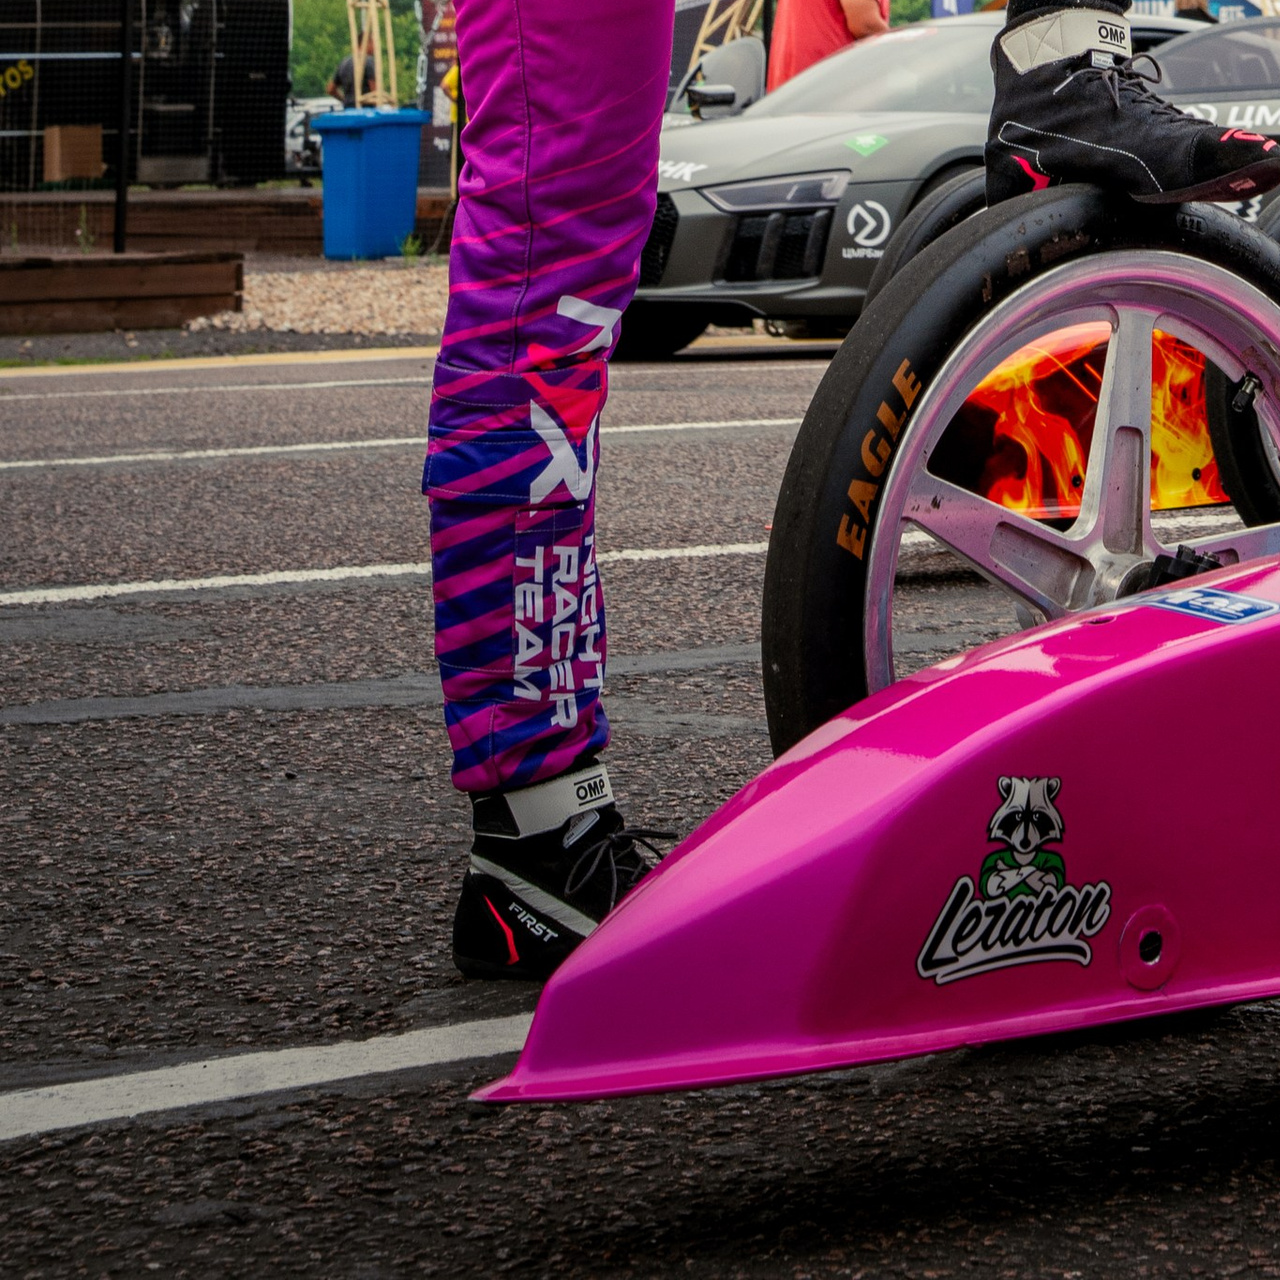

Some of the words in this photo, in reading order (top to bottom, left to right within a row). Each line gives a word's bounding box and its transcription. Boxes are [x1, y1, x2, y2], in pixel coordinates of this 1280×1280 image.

[1097, 24, 1127, 45] OMP
[842, 247, 885, 259] ЦМРБан
[836, 357, 923, 561] EAGLE
[513, 545, 545, 702] TEAM
[549, 545, 580, 729] RACER
[576, 779, 606, 801] OMP
[508, 901, 559, 943] FIRST
